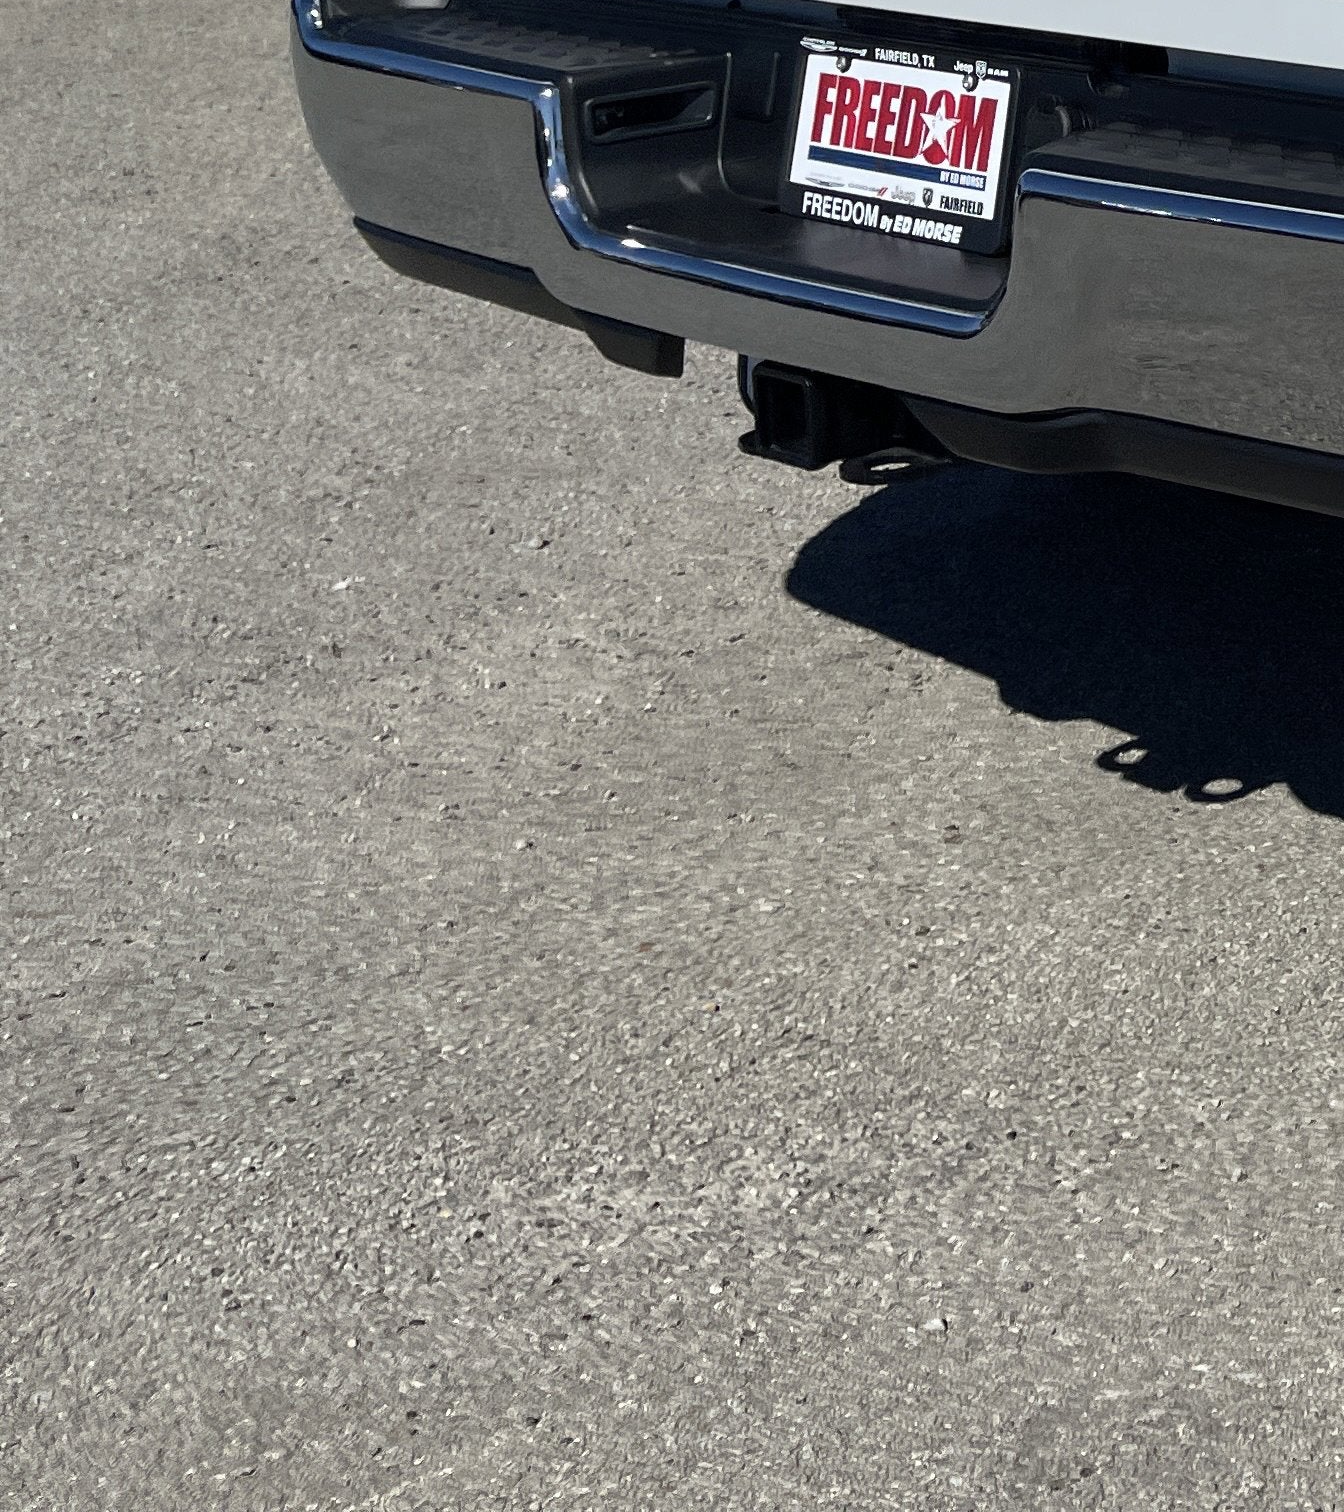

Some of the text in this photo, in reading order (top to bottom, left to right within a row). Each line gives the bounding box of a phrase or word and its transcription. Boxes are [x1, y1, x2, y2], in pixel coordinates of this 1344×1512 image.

[875, 48, 921, 68] FAIRFIELD,
[922, 54, 935, 68] TX
[811, 72, 998, 173] FREEDOM
[959, 174, 985, 189] MORSE
[940, 195, 984, 216] FAIRFIELD
[802, 191, 880, 228] FREEDOM
[893, 214, 913, 234] ED
[912, 218, 963, 244] MORSE
